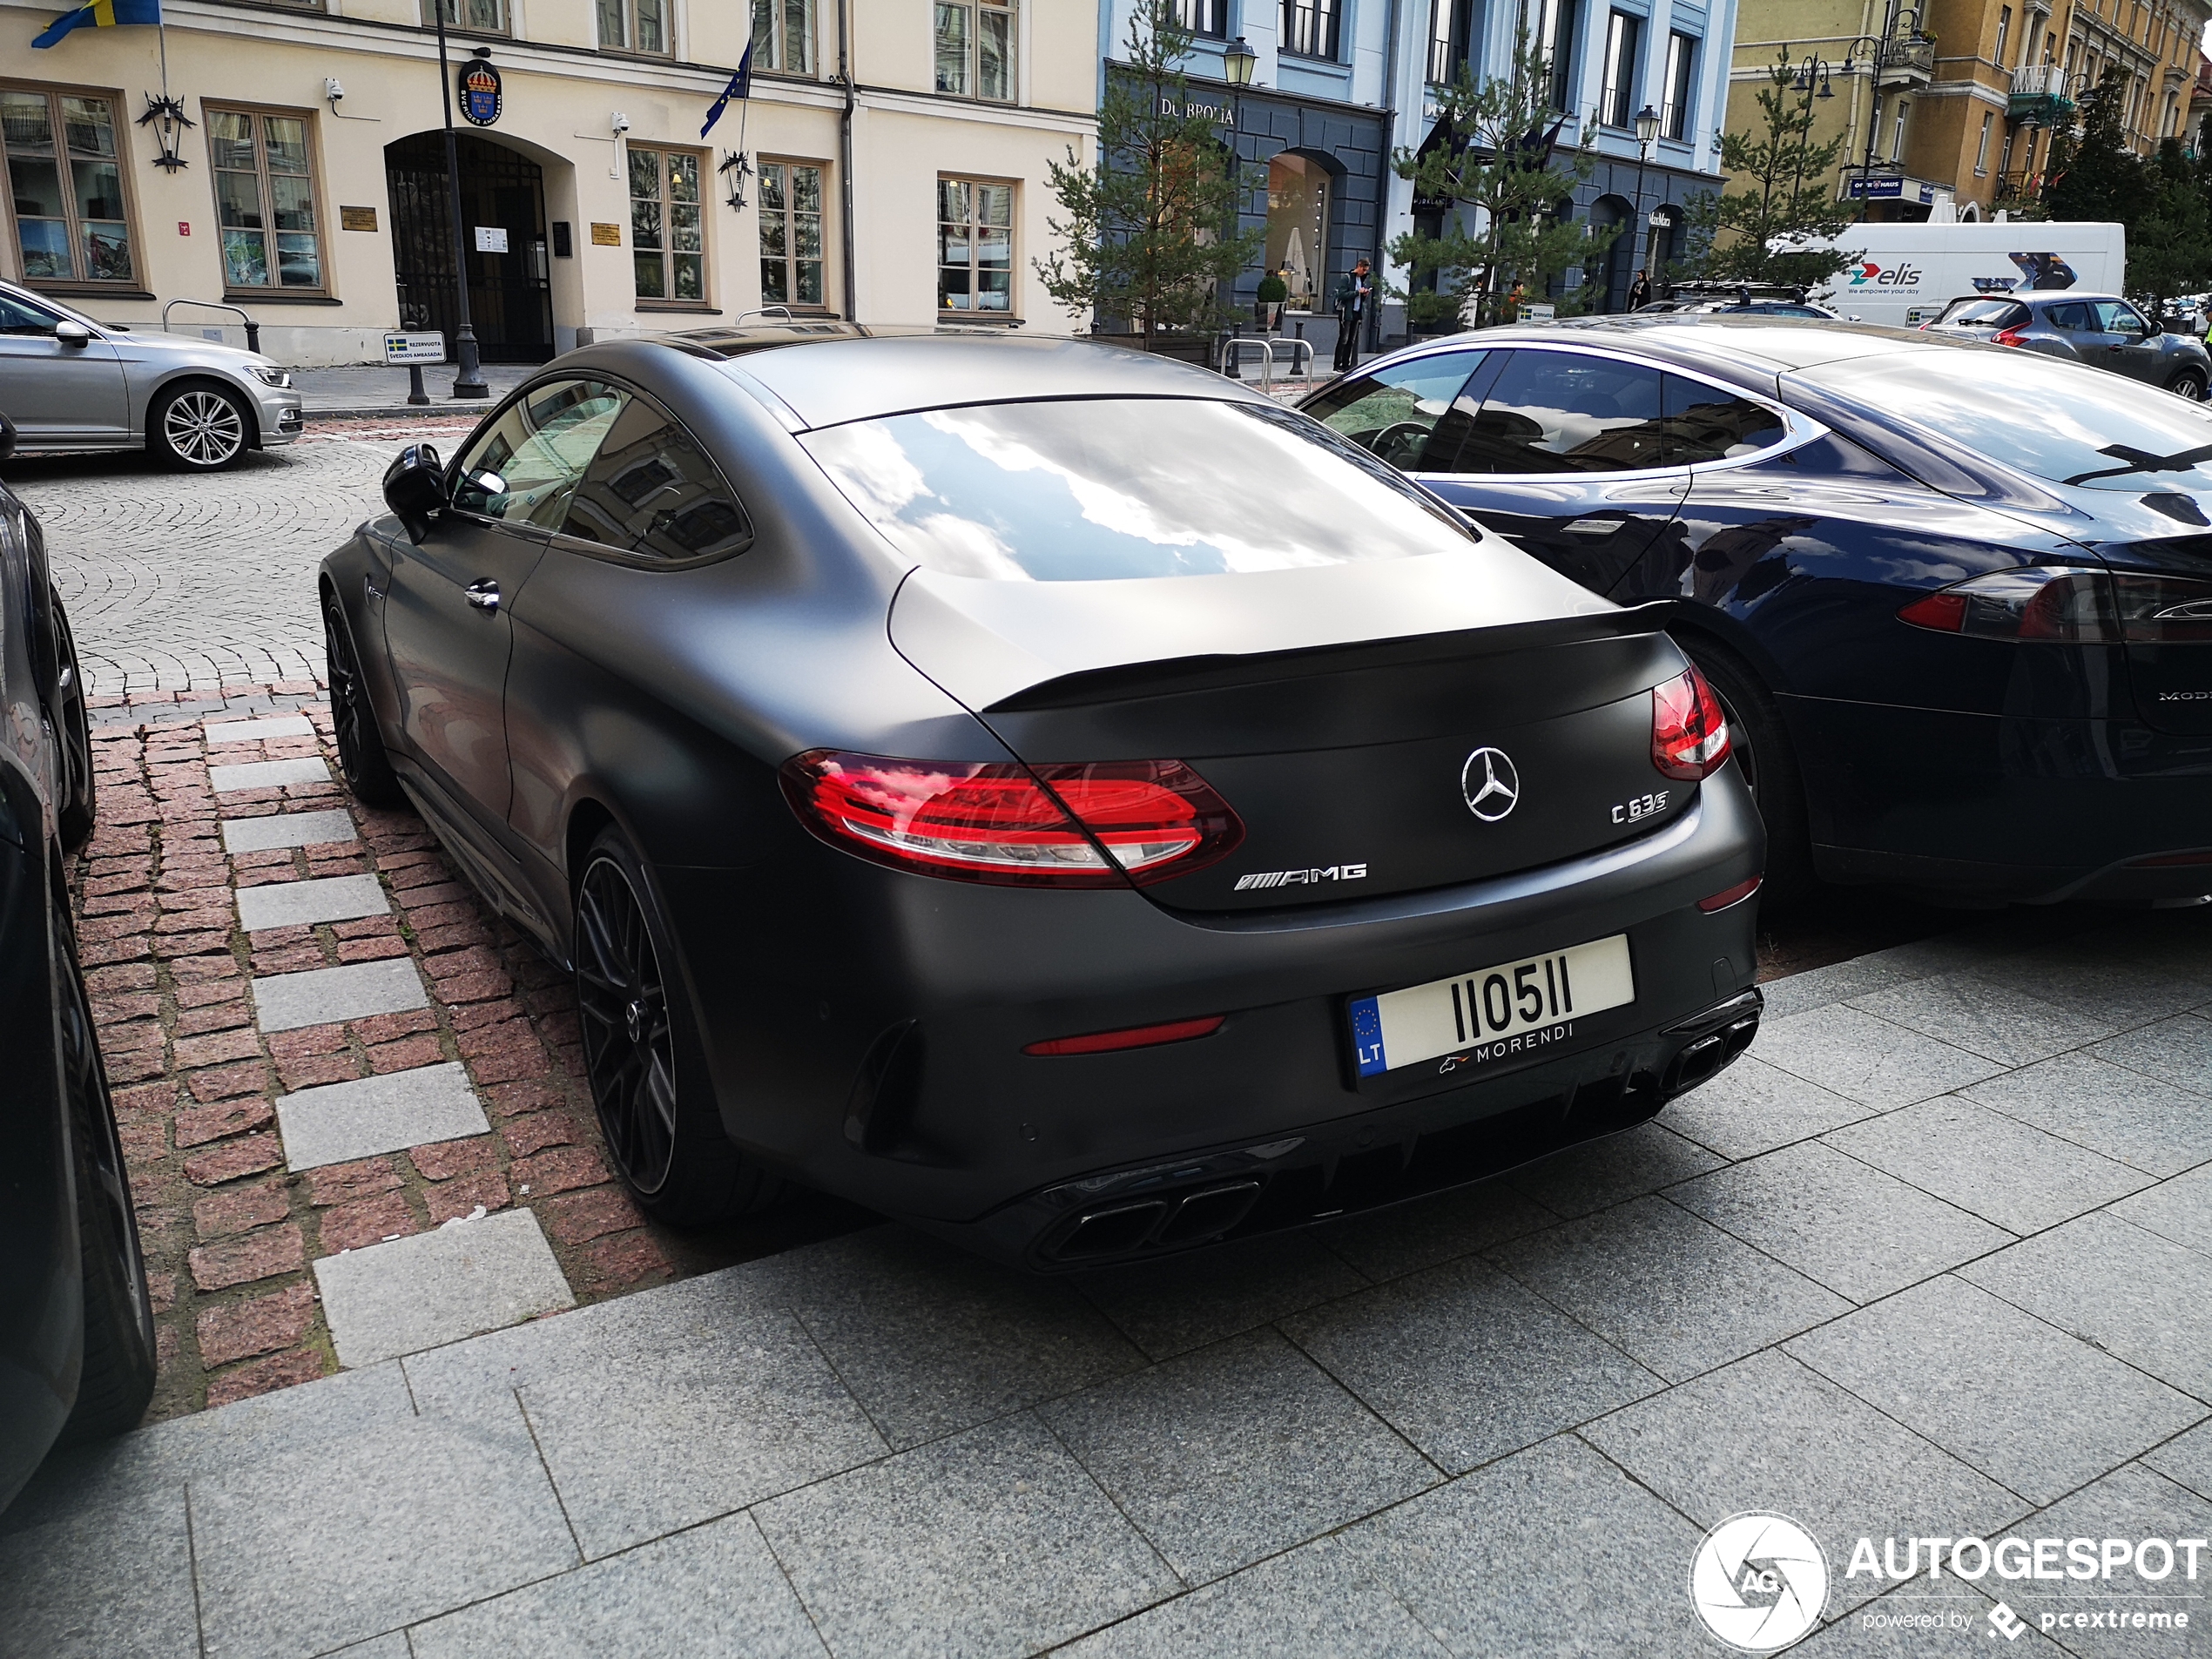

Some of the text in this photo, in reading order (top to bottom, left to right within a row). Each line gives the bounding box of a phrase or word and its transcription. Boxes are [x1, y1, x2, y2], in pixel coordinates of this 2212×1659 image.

[461, 90, 502, 125] SVERIGES AMBASSAD
[1878, 263, 1923, 285] elis
[2159, 691, 2212, 700] MOD
[1358, 1043, 1380, 1064] LT
[1477, 1023, 1573, 1063] MORENDI
